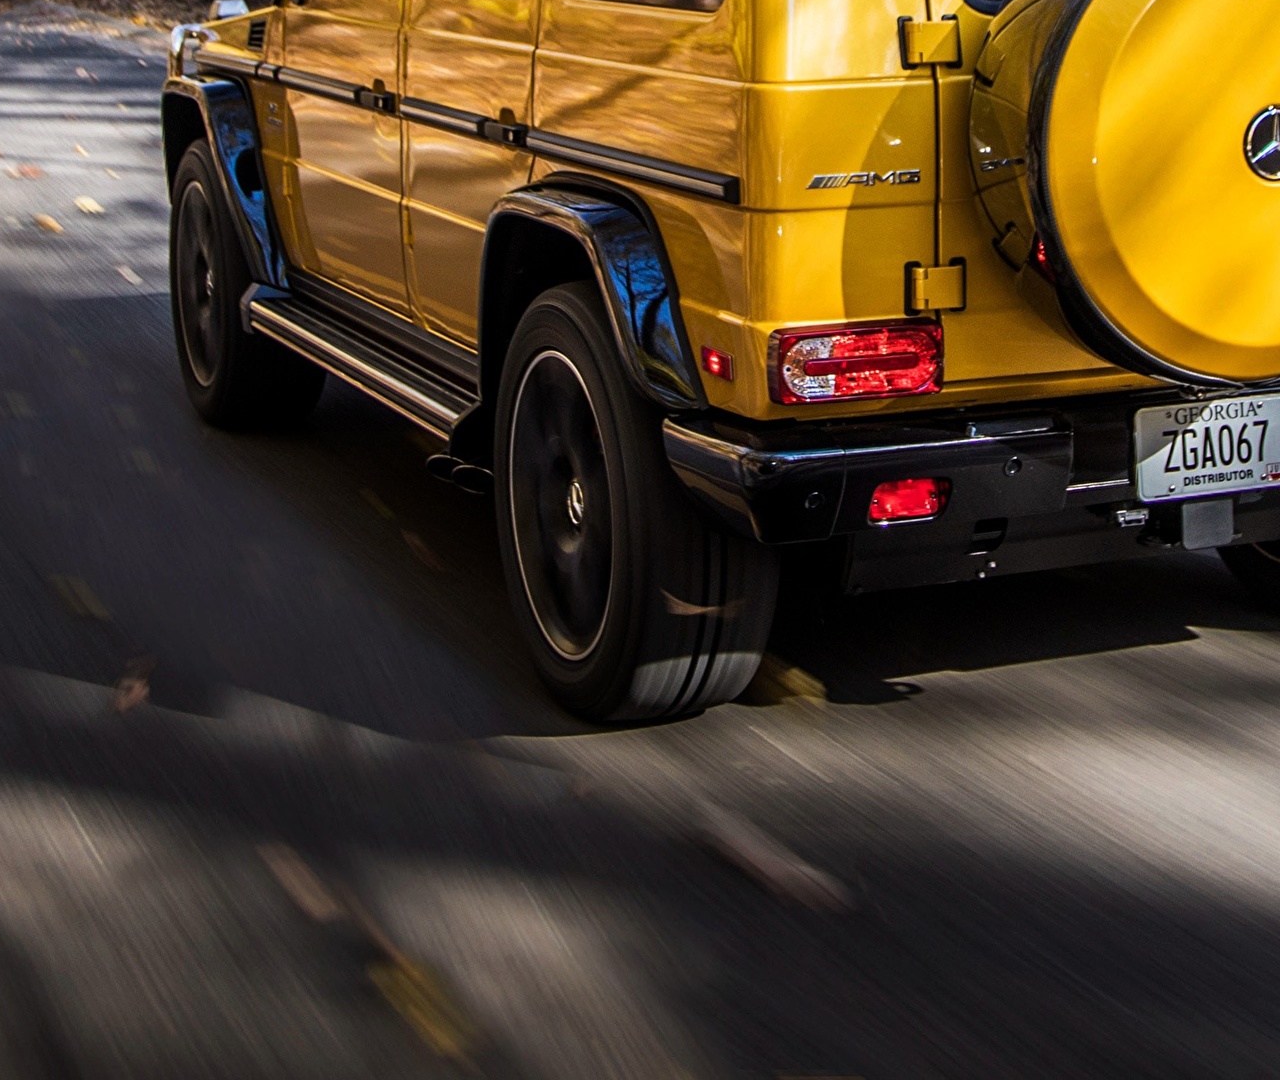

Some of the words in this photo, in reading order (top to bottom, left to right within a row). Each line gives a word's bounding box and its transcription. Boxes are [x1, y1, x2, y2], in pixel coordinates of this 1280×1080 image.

[845, 169, 921, 187] AMG
[1174, 401, 1258, 425] GEORGIA
[1162, 420, 1269, 473] ZGA067
[1183, 469, 1254, 487] DISTRIBUTOR
